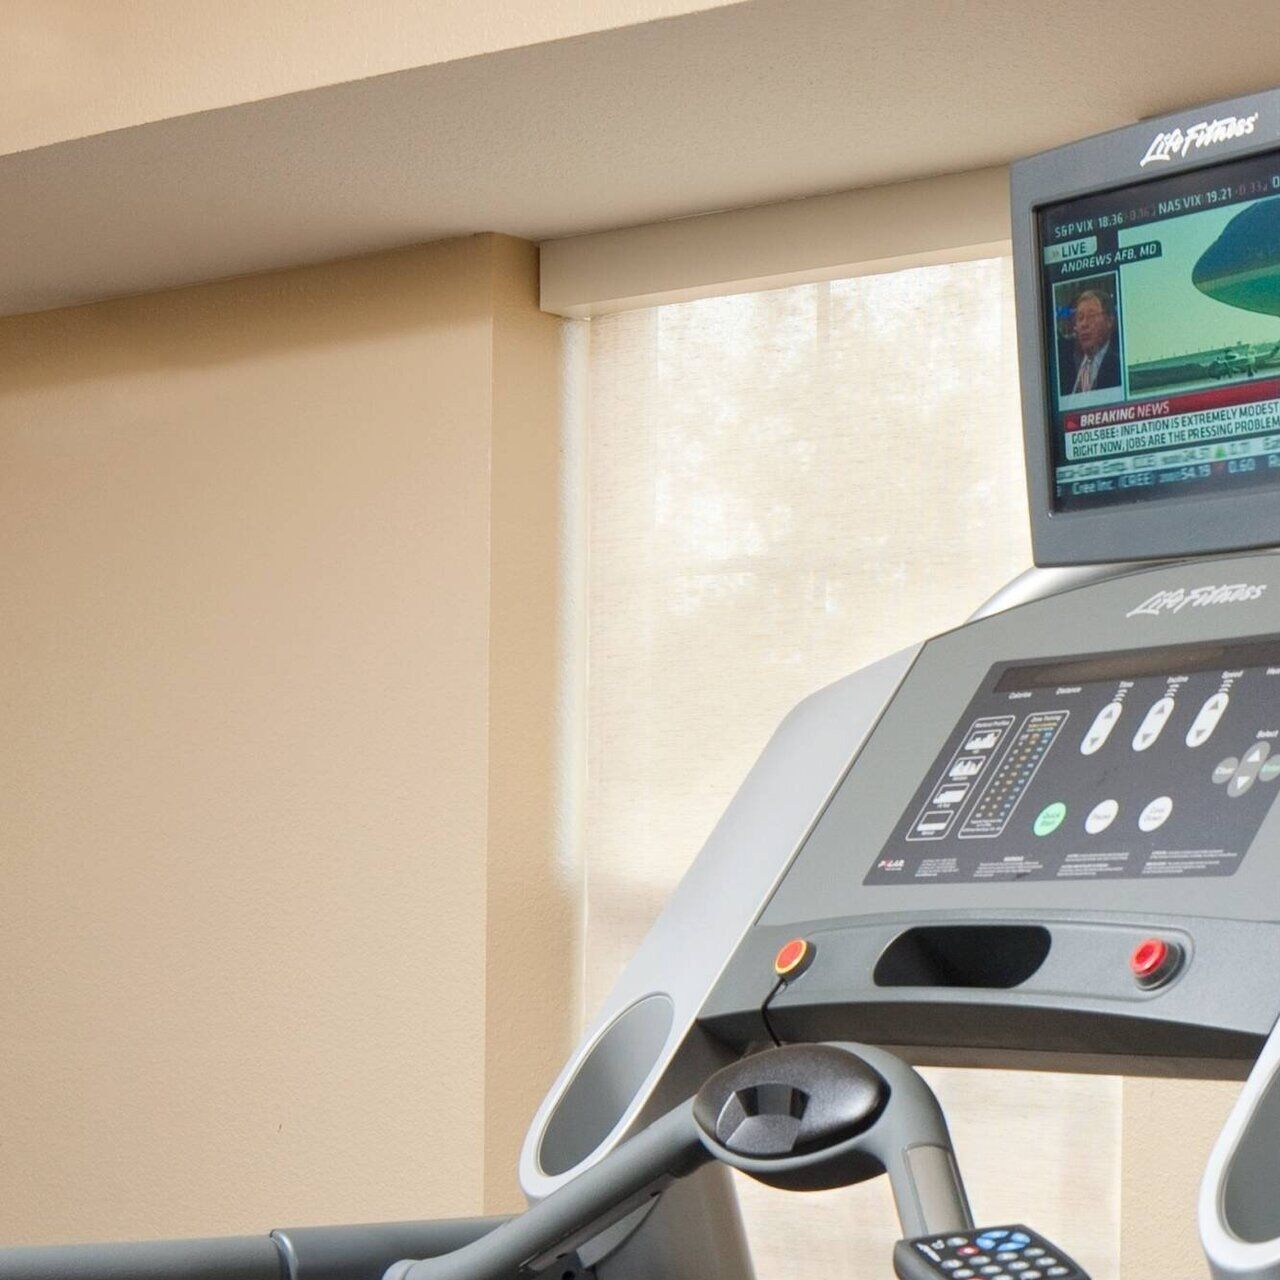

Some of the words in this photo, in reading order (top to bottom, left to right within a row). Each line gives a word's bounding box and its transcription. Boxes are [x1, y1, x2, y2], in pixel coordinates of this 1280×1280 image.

[1139, 127, 1184, 168] Life
[1180, 115, 1255, 158] Fitness
[1077, 216, 1095, 233] VIX
[1158, 199, 1181, 216] NAS
[1183, 193, 1202, 209] VIX
[1206, 187, 1232, 204] 19.21
[1061, 241, 1087, 259] LIVE
[1061, 253, 1113, 275] ANDREWS
[1139, 242, 1158, 258] MD
[1070, 428, 1119, 446] GOOLSBEE:
[1120, 420, 1169, 438] INFLATION
[1170, 417, 1181, 430] IS
[1181, 407, 1239, 428] EXTREMELY
[1239, 401, 1280, 418] MODEST
[1079, 407, 1136, 428] BREAKING
[1136, 400, 1171, 419] NEWS
[1072, 443, 1099, 458] RIGHT
[1126, 436, 1147, 452] JOBS
[1147, 433, 1168, 447] ARE
[1168, 429, 1187, 444] THE
[1187, 420, 1234, 440] PRESSING
[1126, 588, 1185, 619] Life
[1173, 583, 1267, 615] Fitness
